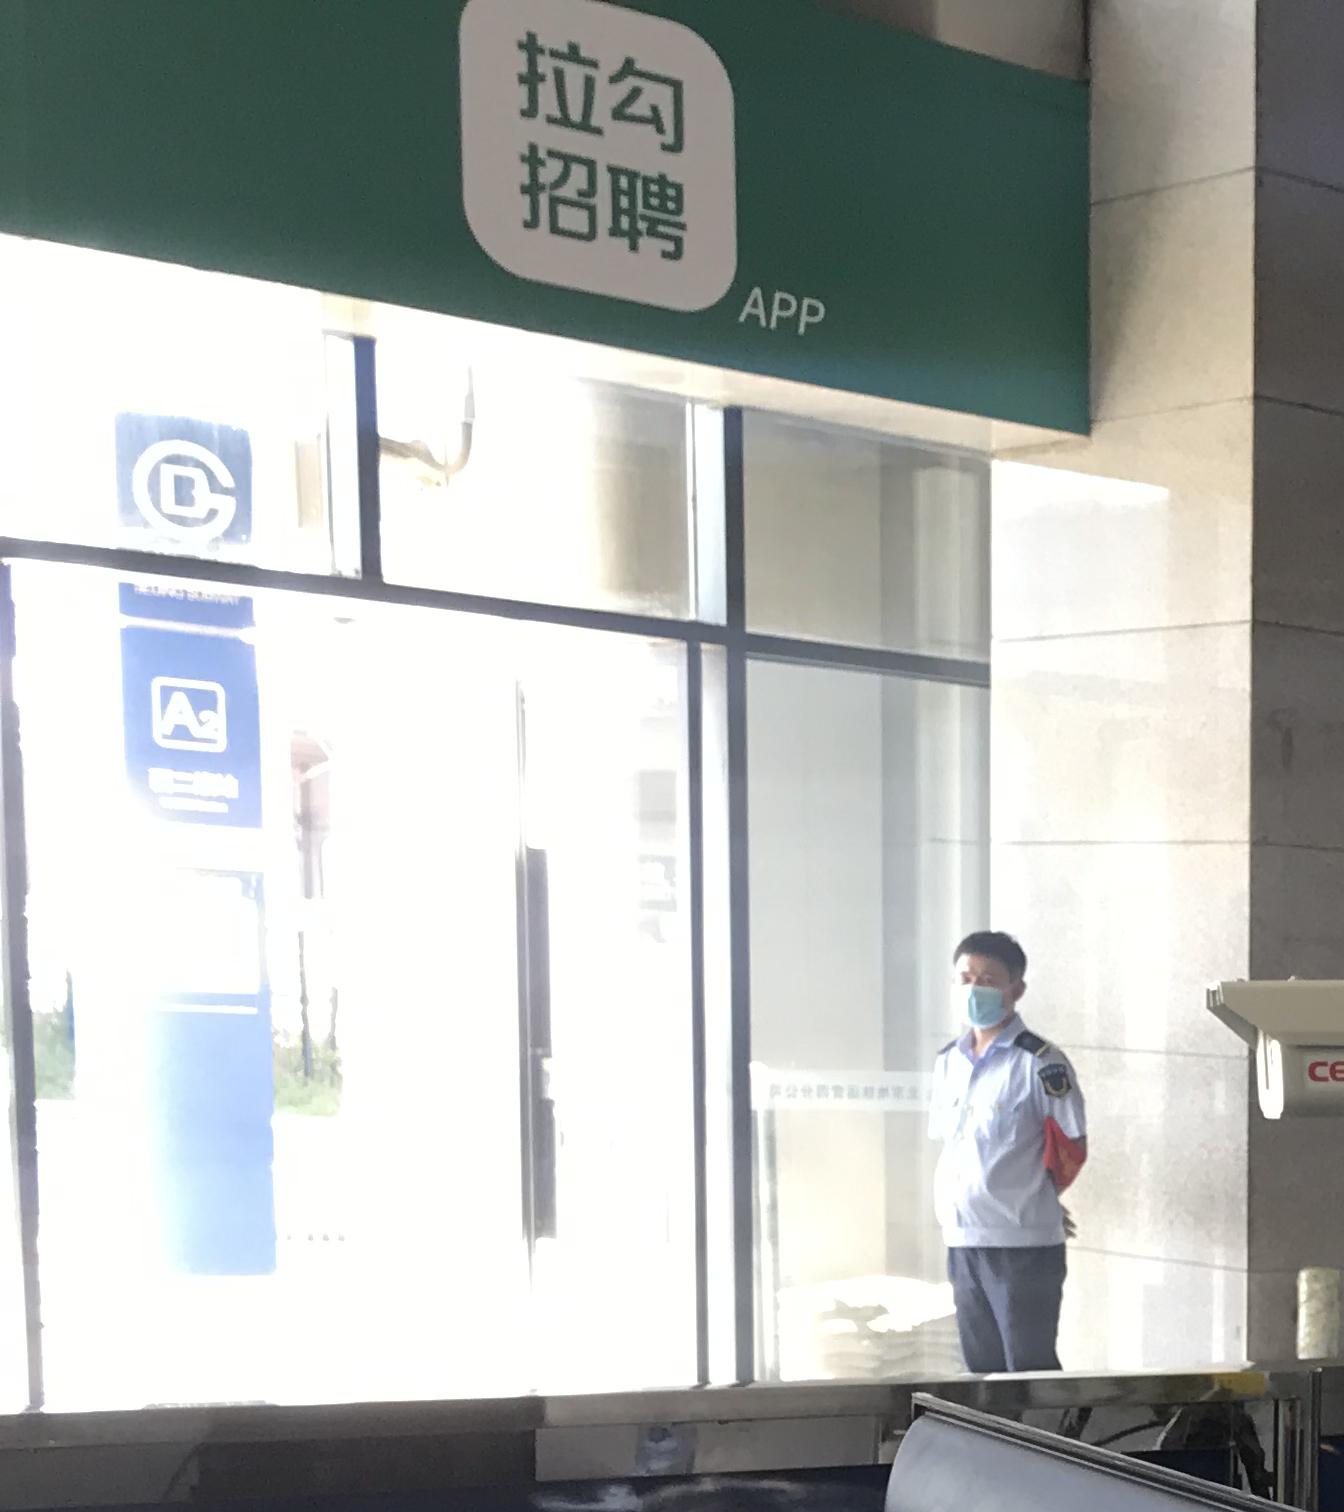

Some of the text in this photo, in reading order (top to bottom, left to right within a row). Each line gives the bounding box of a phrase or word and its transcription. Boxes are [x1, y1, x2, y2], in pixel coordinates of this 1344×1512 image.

[517, 31, 684, 153] 拉勾
[520, 142, 687, 261] 招聘
[738, 286, 826, 335] APP
